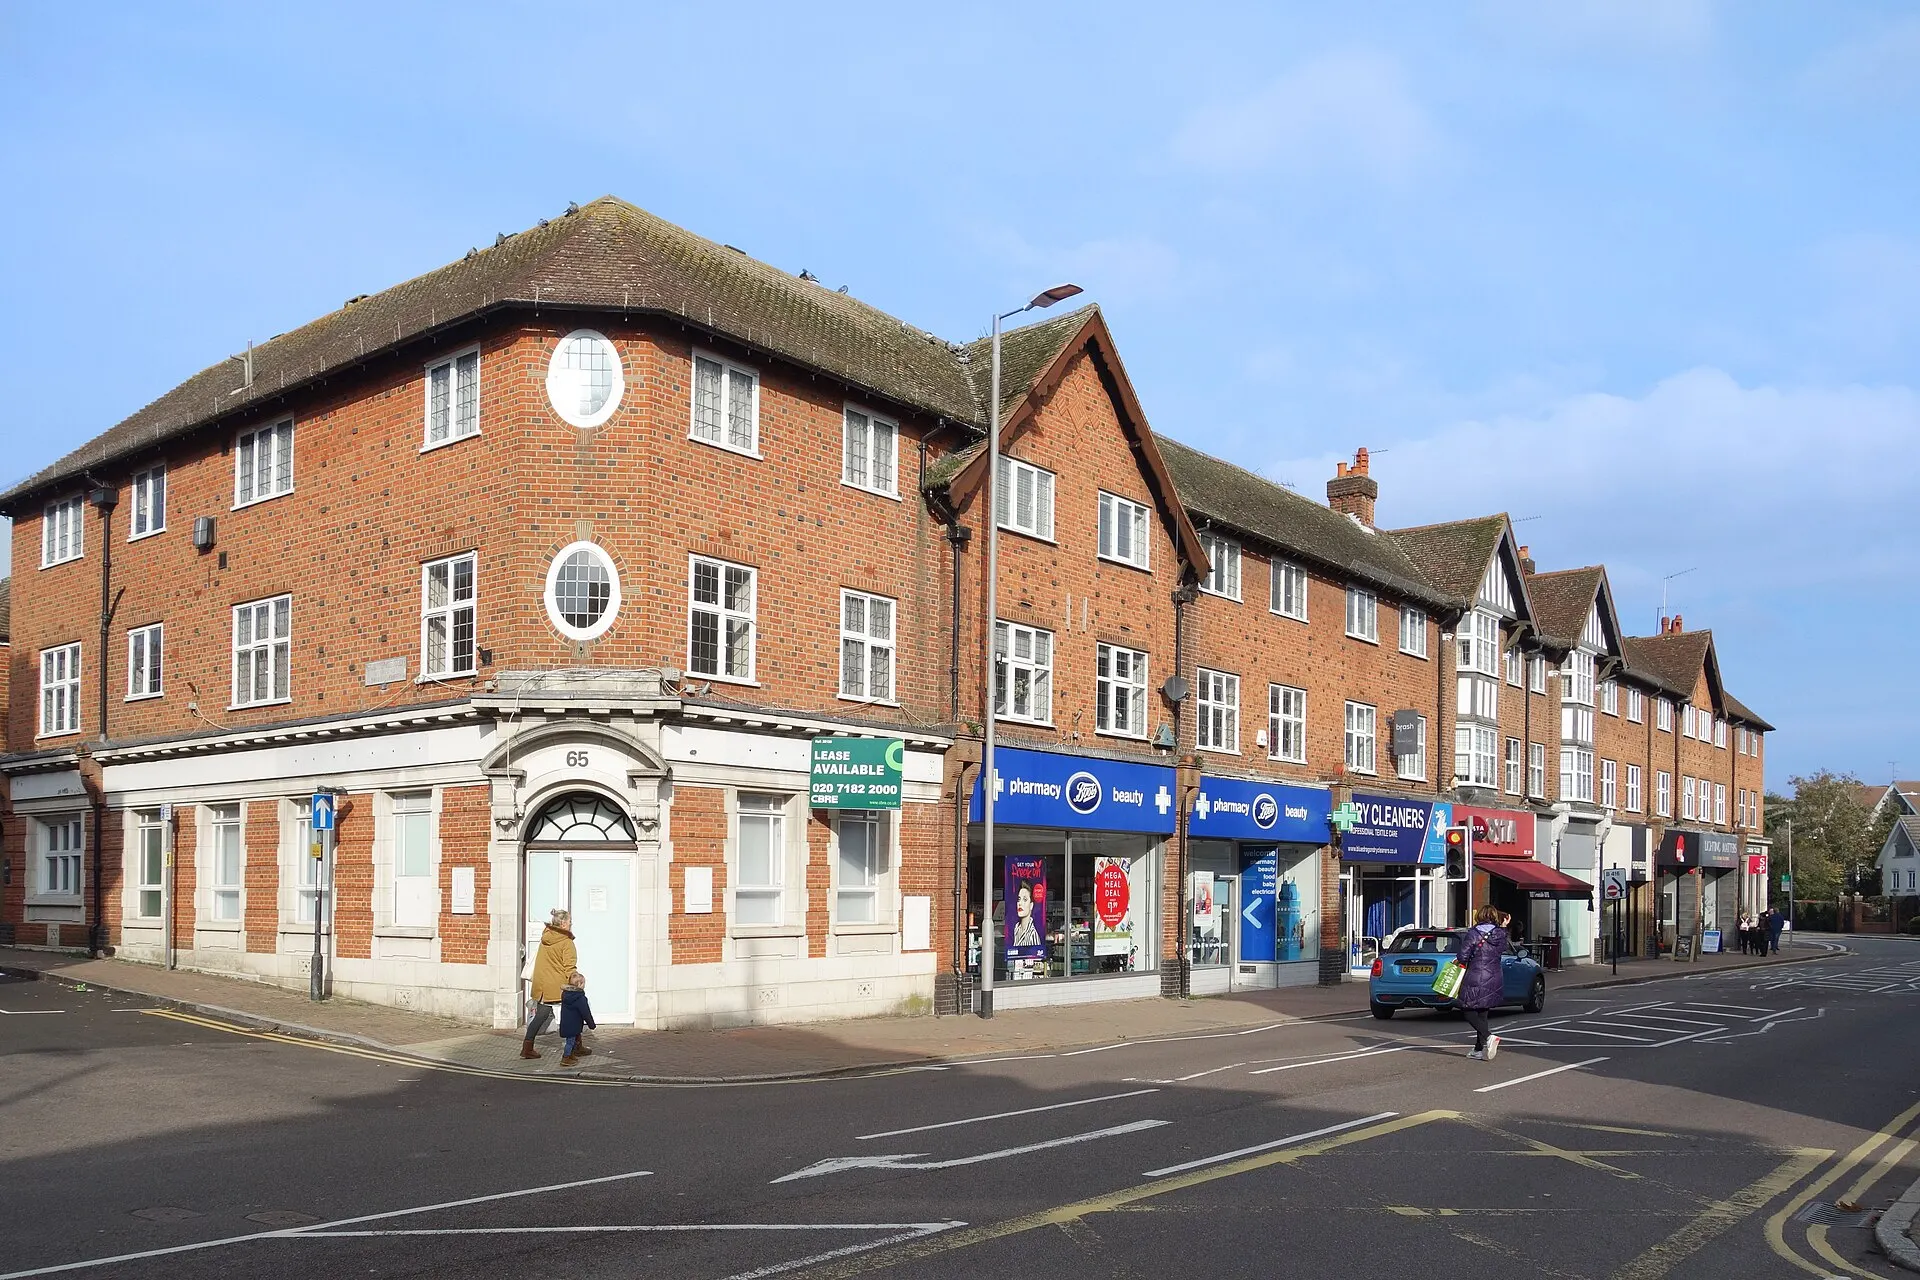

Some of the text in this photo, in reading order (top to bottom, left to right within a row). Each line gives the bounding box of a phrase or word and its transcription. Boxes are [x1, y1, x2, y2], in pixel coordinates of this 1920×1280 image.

[566, 751, 589, 767] 65
[814, 751, 850, 760] LEASE
[813, 764, 885, 775] AVAILABLE
[812, 784, 898, 794] 020 7182 2000
[1009, 777, 1062, 799] pharmacy
[1113, 787, 1144, 807] beauty
[811, 795, 839, 803] CBRE
[1213, 798, 1250, 816] pharmacy
[1285, 805, 1308, 821] beauty
[1371, 804, 1424, 829] CLEANERS
[1347, 827, 1374, 836] OFESSIONAL
[1374, 829, 1388, 837] TEXTILE
[1759, 857, 1765, 865] S
[1104, 871, 1122, 879] MEGA
[1441, 964, 1458, 992] WAITROS
